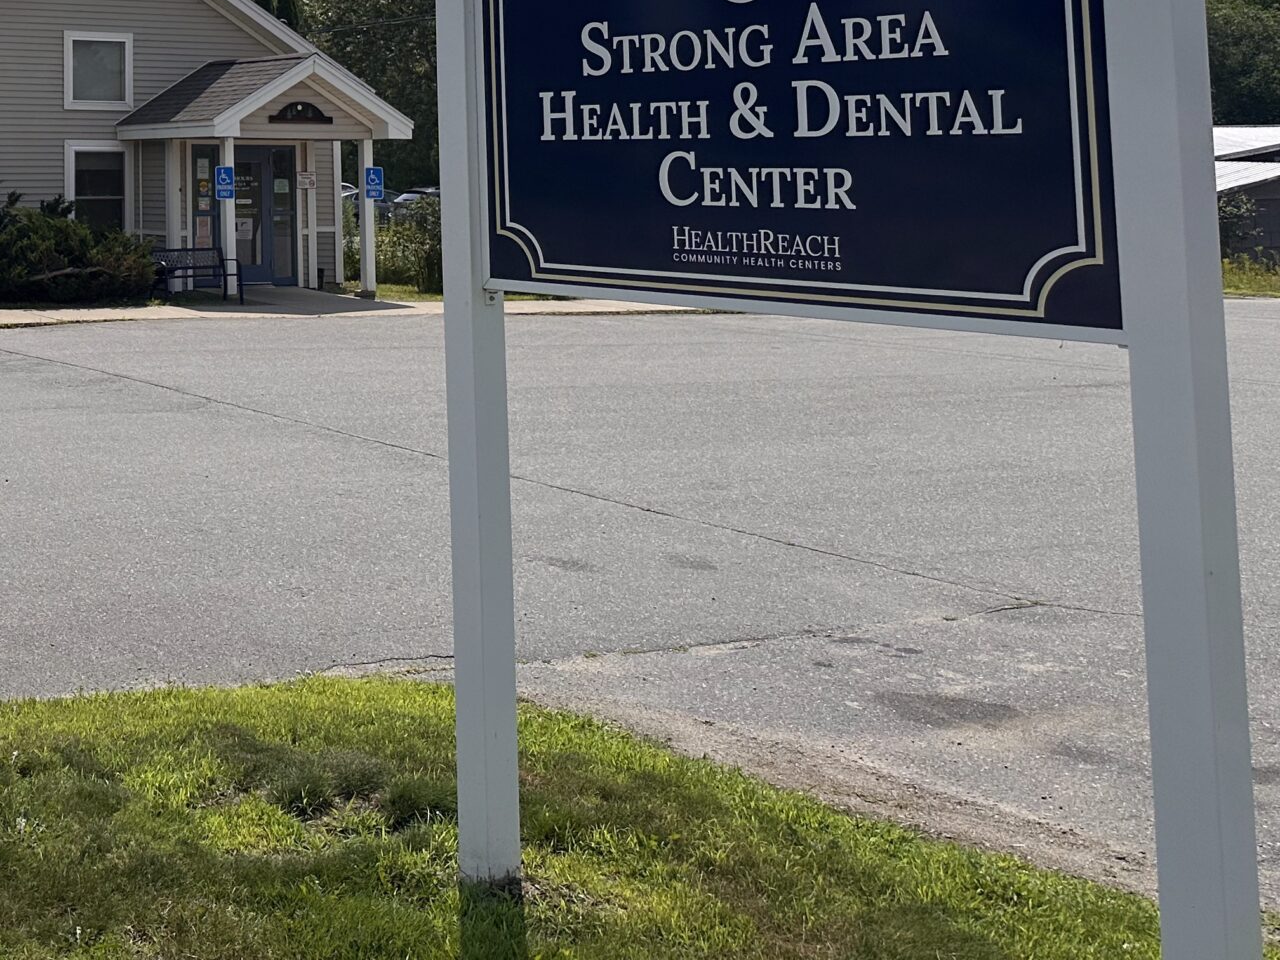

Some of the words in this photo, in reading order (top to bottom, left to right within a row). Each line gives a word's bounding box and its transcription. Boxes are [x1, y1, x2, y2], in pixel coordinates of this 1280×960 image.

[581, 21, 774, 77] STRONG
[792, 2, 949, 64] AREA
[538, 90, 711, 141] HEALTH
[729, 81, 774, 140] &
[791, 79, 1023, 138] DENTAL
[658, 150, 857, 210] CENTER
[673, 252, 738, 265] COMMUNITY
[742, 256, 785, 269] HEALTH
[789, 258, 842, 271] CENTERS
